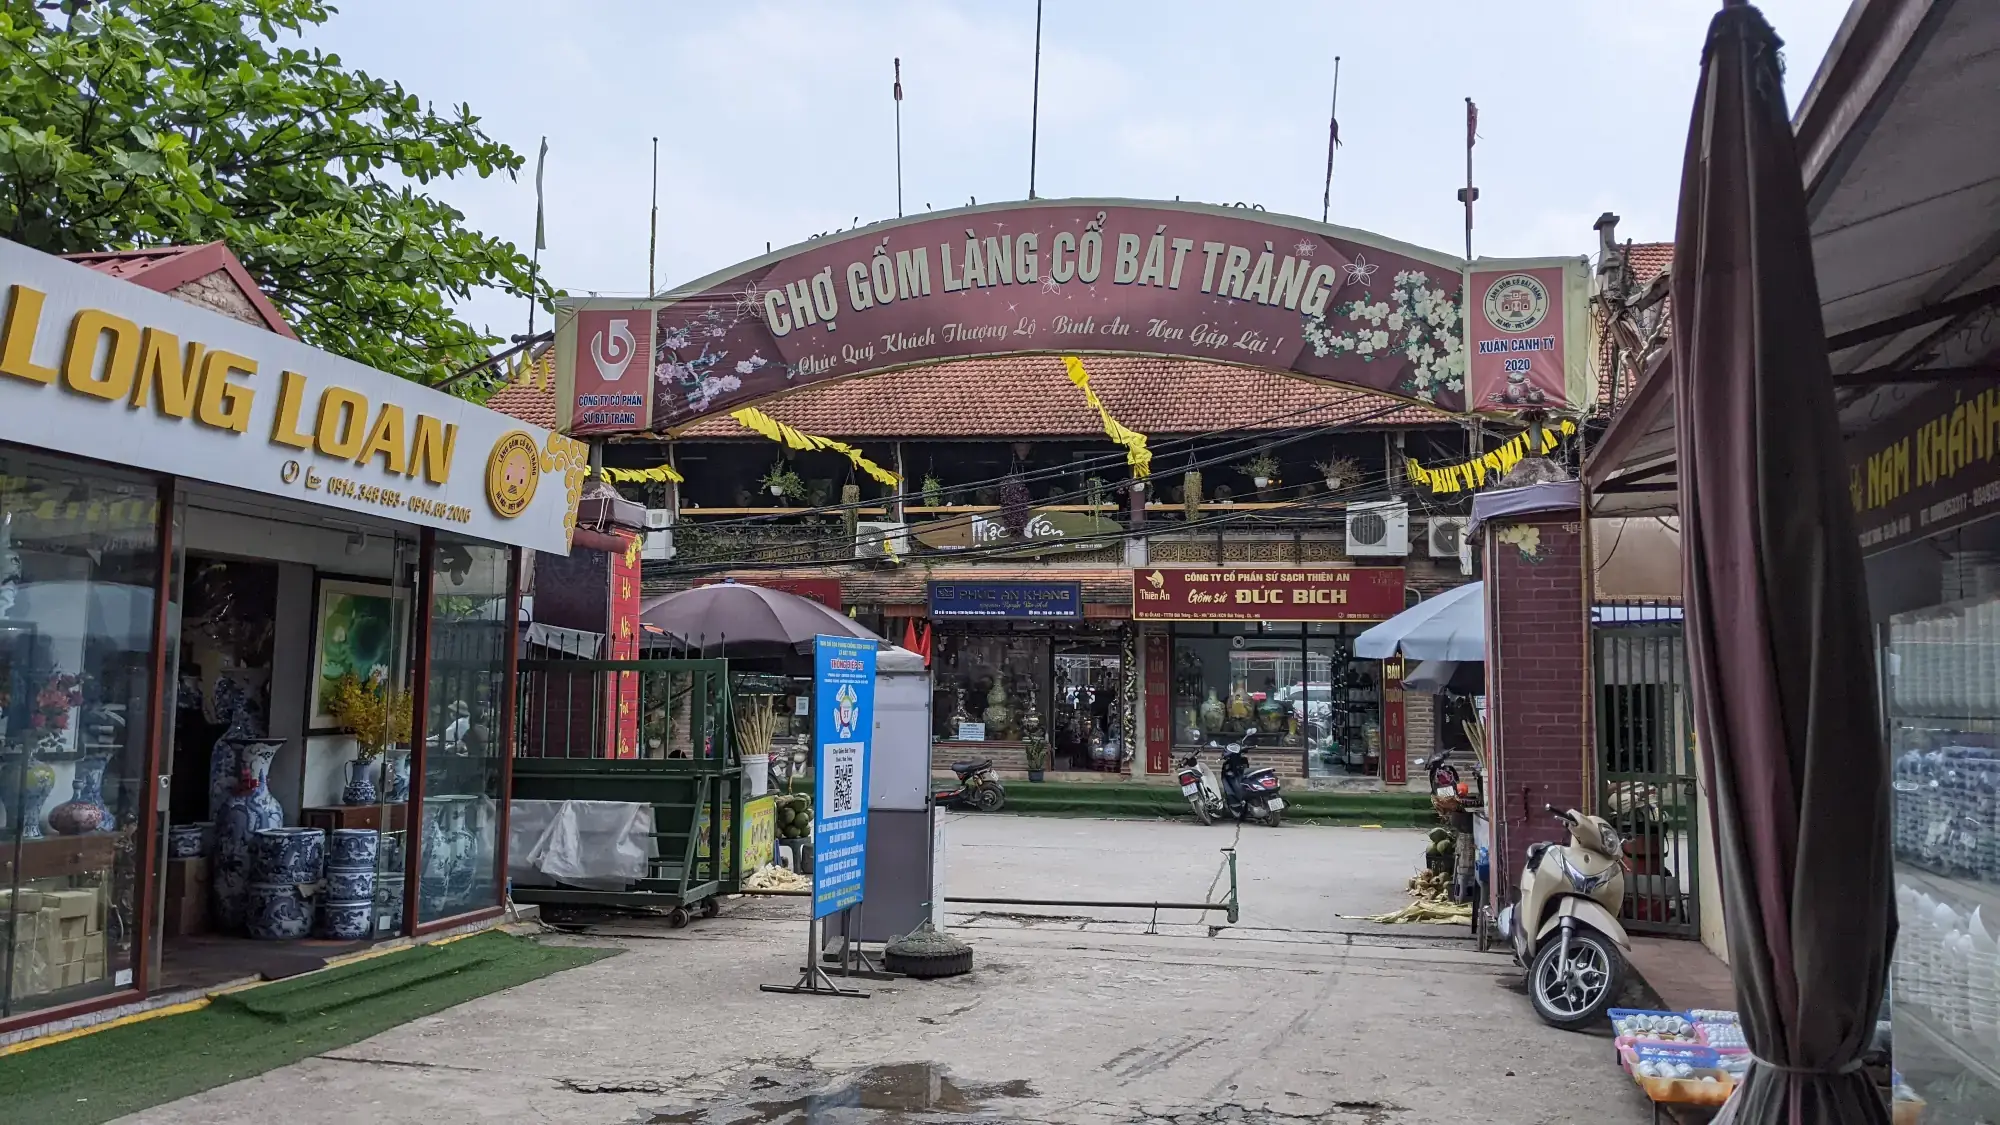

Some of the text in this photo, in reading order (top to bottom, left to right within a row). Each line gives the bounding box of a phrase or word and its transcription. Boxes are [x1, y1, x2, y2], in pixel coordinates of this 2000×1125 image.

[764, 211, 1336, 337] CHỢ GỐM LÀNG CỔ BÁT TRÀNG
[1521, 279, 1532, 288] BÁT
[798, 351, 837, 376] Chúc
[841, 342, 875, 366] Quý
[880, 328, 936, 355] Khách
[941, 323, 1008, 343] Thượng
[1052, 315, 1095, 335] Bình
[1101, 316, 1130, 336] An
[1146, 318, 1184, 343] Hẹn
[1189, 323, 1229, 348] Gặp
[1479, 338, 1508, 354] XUÂN
[1511, 337, 1540, 352] CANH
[1505, 358, 1531, 372] 2020
[0, 284, 459, 486] LONG LOAN
[578, 393, 598, 407] CÔNG
[599, 395, 608, 406] TY
[1868, 389, 2000, 509] NAM KHÁNH
[1184, 571, 1209, 582] CÔNG
[1210, 573, 1222, 582] TY
[1223, 570, 1236, 582] CỔ
[1266, 571, 1279, 582] SỨ
[1280, 573, 1305, 583] SẠCH
[1306, 571, 1334, 582] THIÊN
[1336, 573, 1350, 582] AN
[1001, 590, 1019, 600] AN
[1023, 590, 1070, 600] KHANG
[1140, 588, 1170, 601] Thiên An
[1187, 588, 1212, 605] Gốm
[1234, 585, 1284, 604] ĐỨC
[1292, 585, 1348, 604] BÍCH
[1386, 662, 1400, 679] BÁN
[843, 709, 850, 719] 5T
